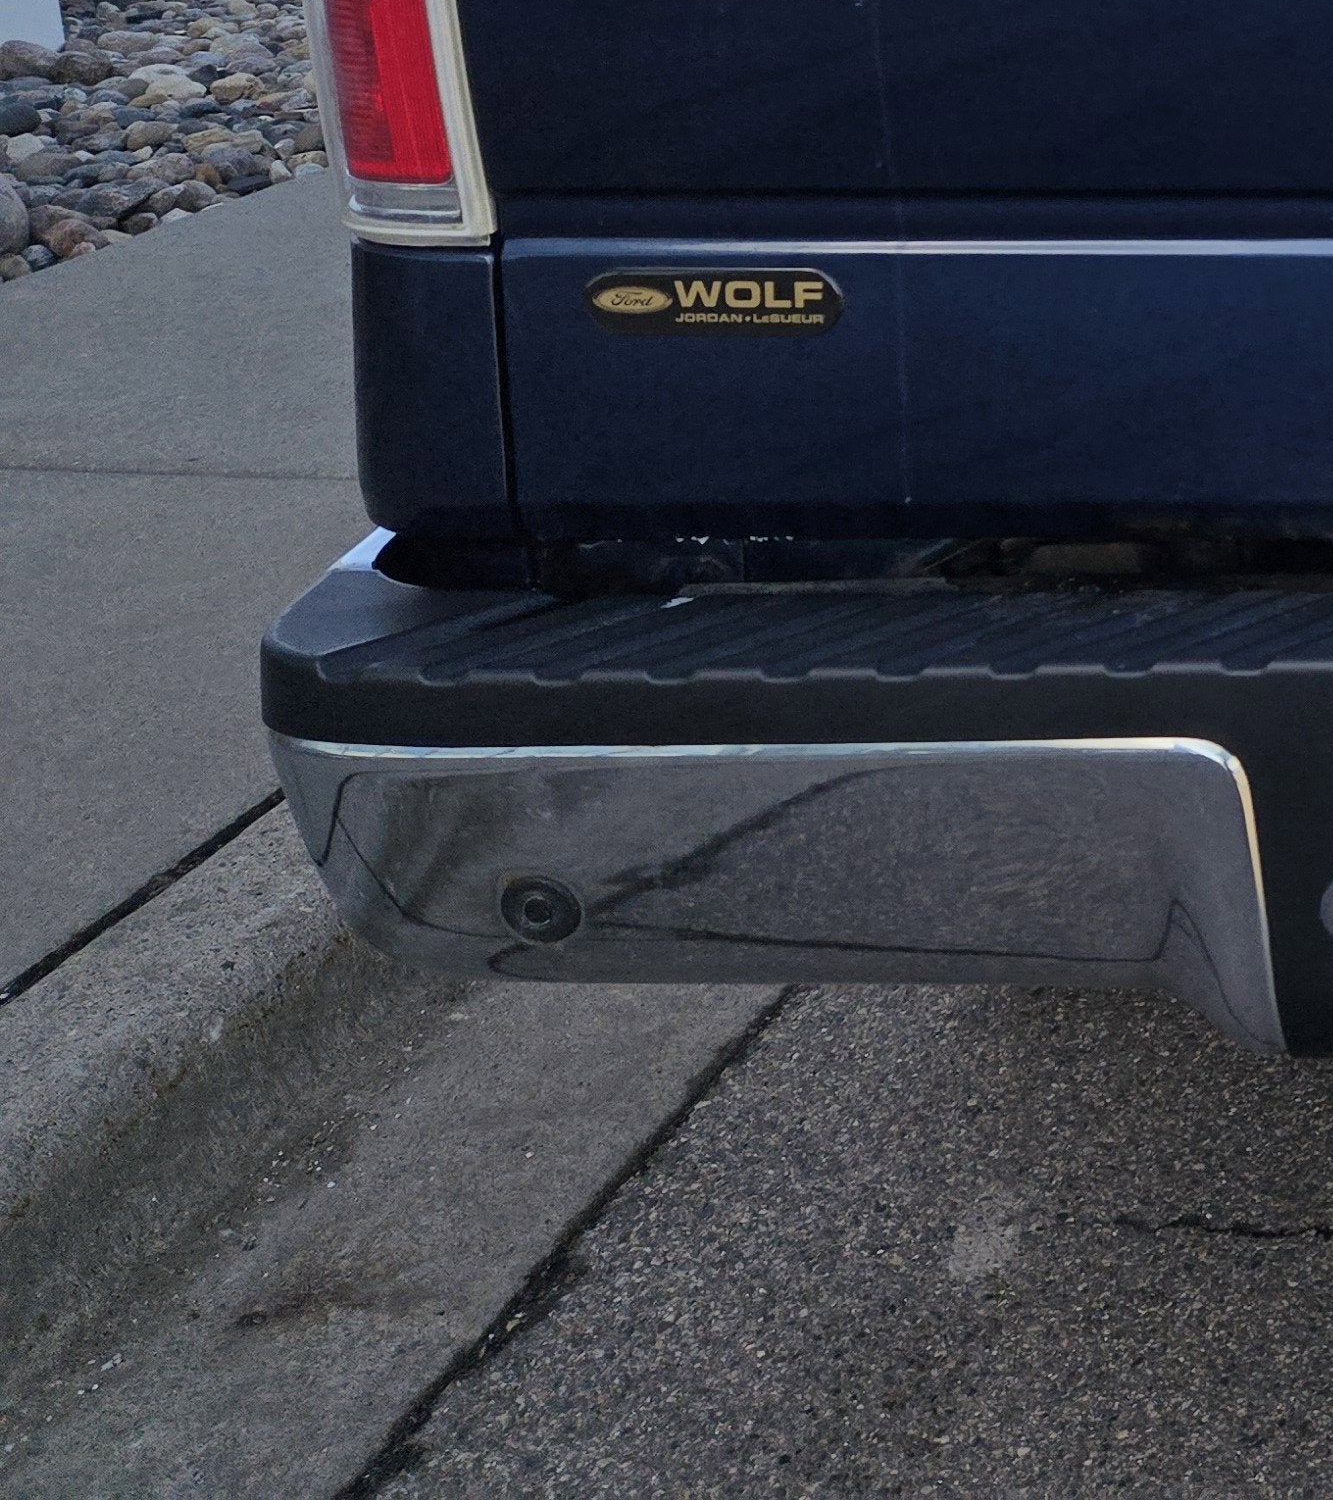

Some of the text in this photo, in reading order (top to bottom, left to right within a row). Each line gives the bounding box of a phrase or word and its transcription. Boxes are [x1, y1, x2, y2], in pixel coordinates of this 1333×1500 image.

[610, 291, 654, 308] Ford
[674, 280, 824, 308] WOLF
[675, 313, 743, 323] JORDAN
